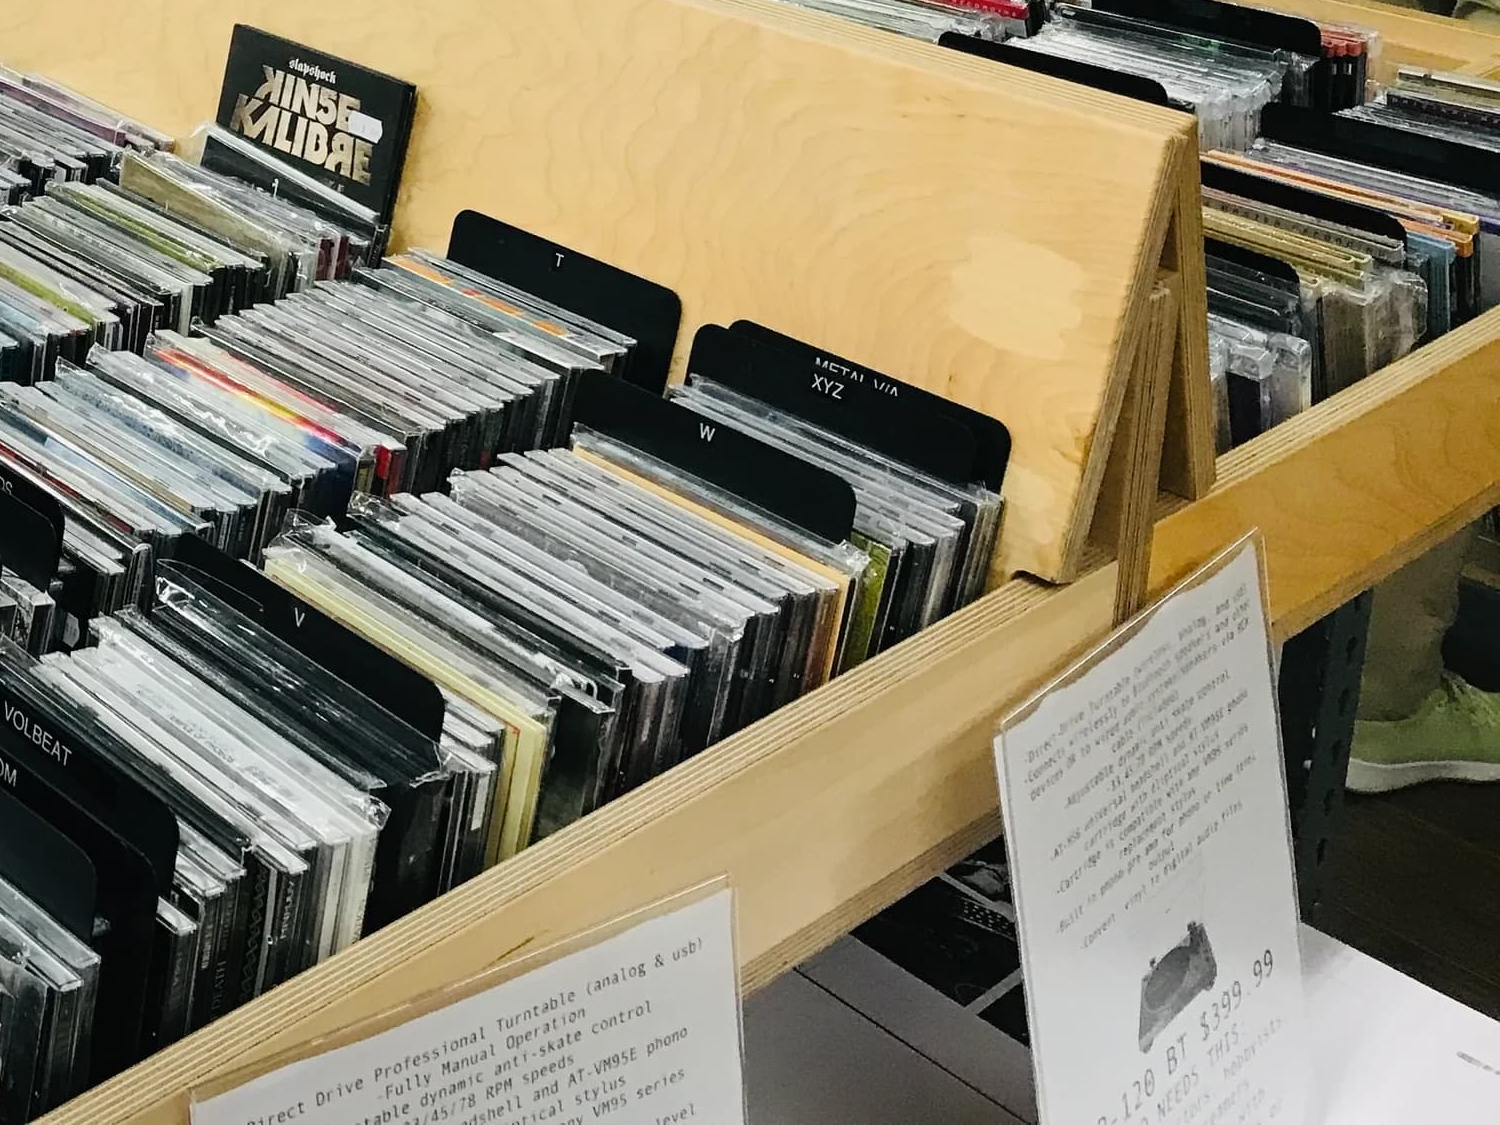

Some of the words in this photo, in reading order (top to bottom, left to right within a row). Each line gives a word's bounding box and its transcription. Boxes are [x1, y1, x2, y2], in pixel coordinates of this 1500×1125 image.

[289, 58, 337, 85] slapshock
[230, 92, 375, 186] KALIBRE
[555, 252, 565, 268] T
[811, 373, 845, 400] XYZ
[698, 423, 716, 442] W
[294, 606, 306, 628] V
[4, 701, 72, 767] VOLBEAT
[316, 1077, 364, 1107] Drive
[374, 1027, 486, 1084] Professional
[497, 990, 576, 1036] Turntable
[586, 960, 646, 998] (analog
[654, 953, 666, 970] &
[672, 937, 703, 965] usb)
[1165, 1031, 1187, 1075] BT
[1200, 948, 1273, 1040] $399.99
[419, 1072, 484, 1120] dynamic
[494, 1029, 582, 1077] anti-skate
[591, 1000, 653, 1037] control
[441, 1045, 496, 1082] Manual
[505, 1007, 587, 1050] Operation
[532, 1080, 560, 1104] and
[567, 1047, 638, 1089] AT-VM95E
[646, 1027, 689, 1058] phono
[485, 1077, 514, 1101] RPM
[522, 1055, 575, 1086] speeds
[575, 1075, 627, 1106] stylus
[592, 1095, 628, 1119] VM95
[636, 1068, 686, 1099] series
[1156, 1064, 1199, 1120] NEEDS
